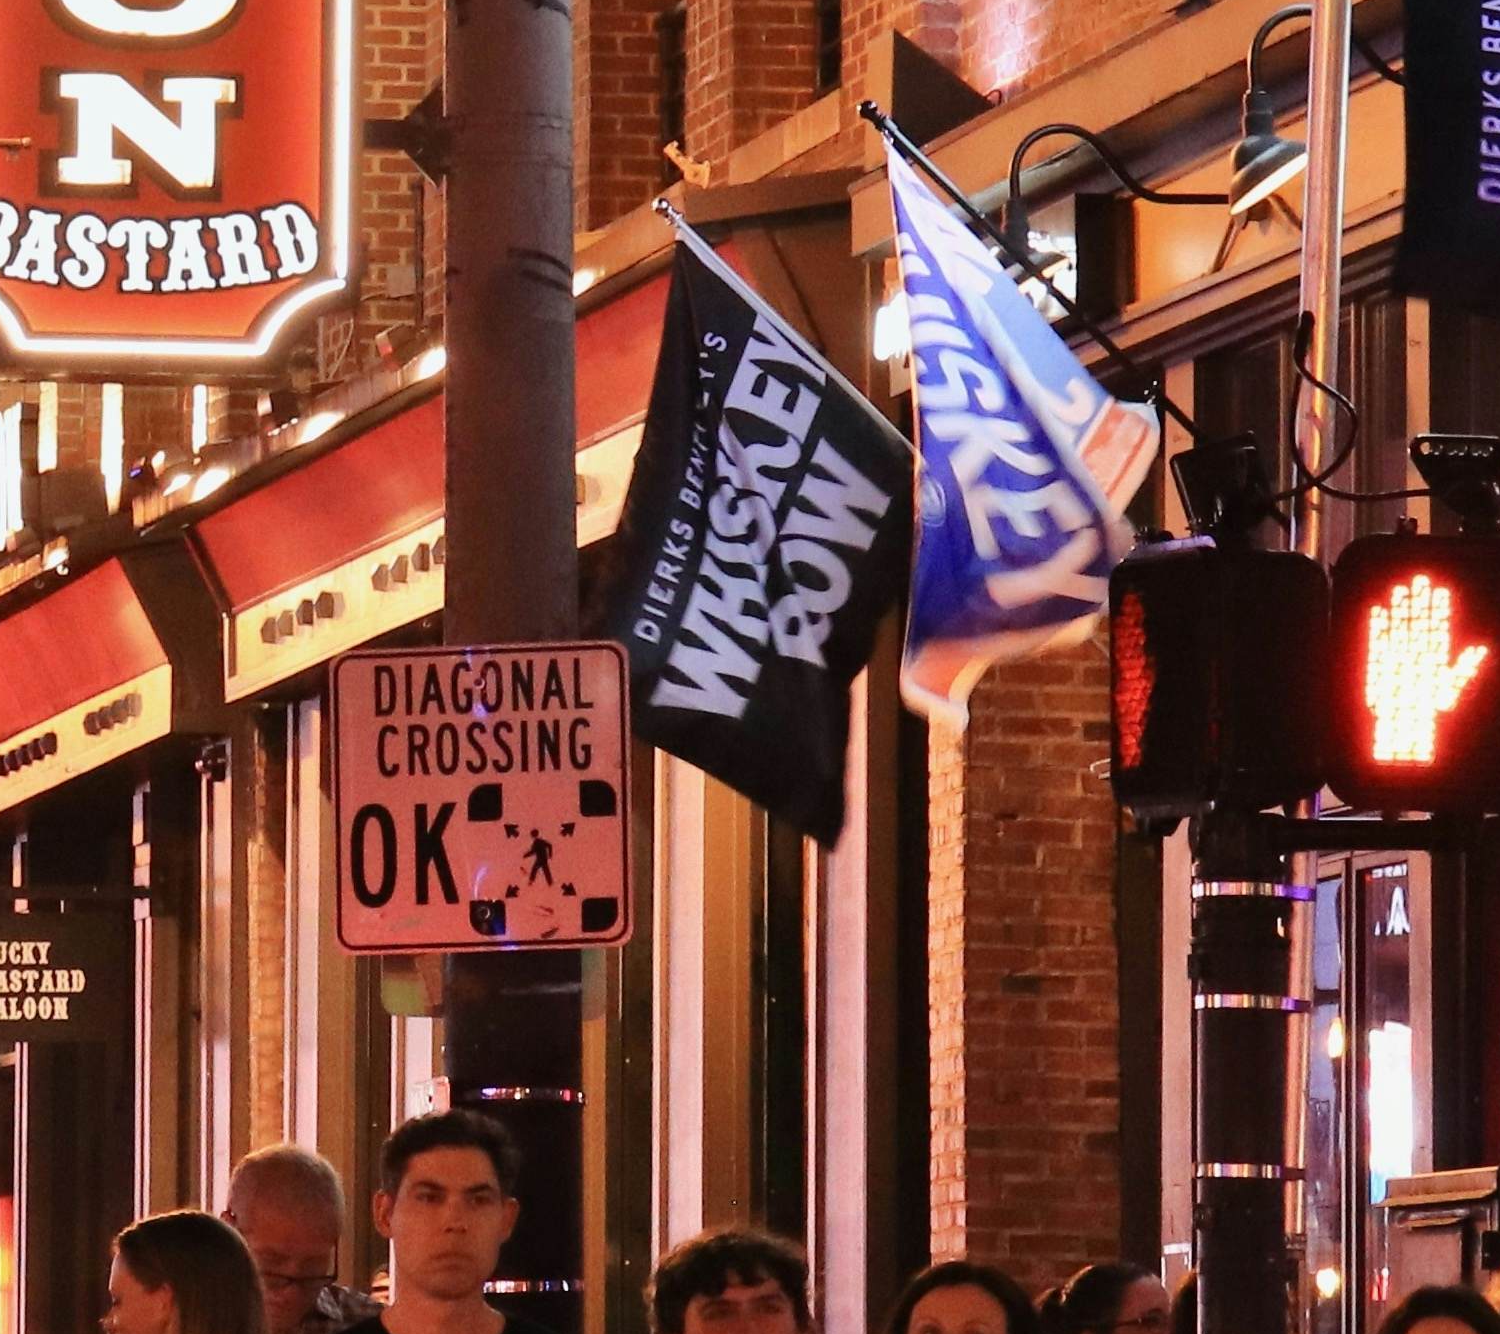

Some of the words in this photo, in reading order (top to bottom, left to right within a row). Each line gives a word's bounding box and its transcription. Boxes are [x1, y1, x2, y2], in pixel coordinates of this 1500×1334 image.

[650, 312, 828, 720] WHISKEY
[768, 436, 893, 669] ROW
[633, 516, 694, 645] DIERKS
[373, 657, 594, 717] DIAGONAL
[376, 717, 593, 779] CROSSING
[350, 801, 460, 909] OK
